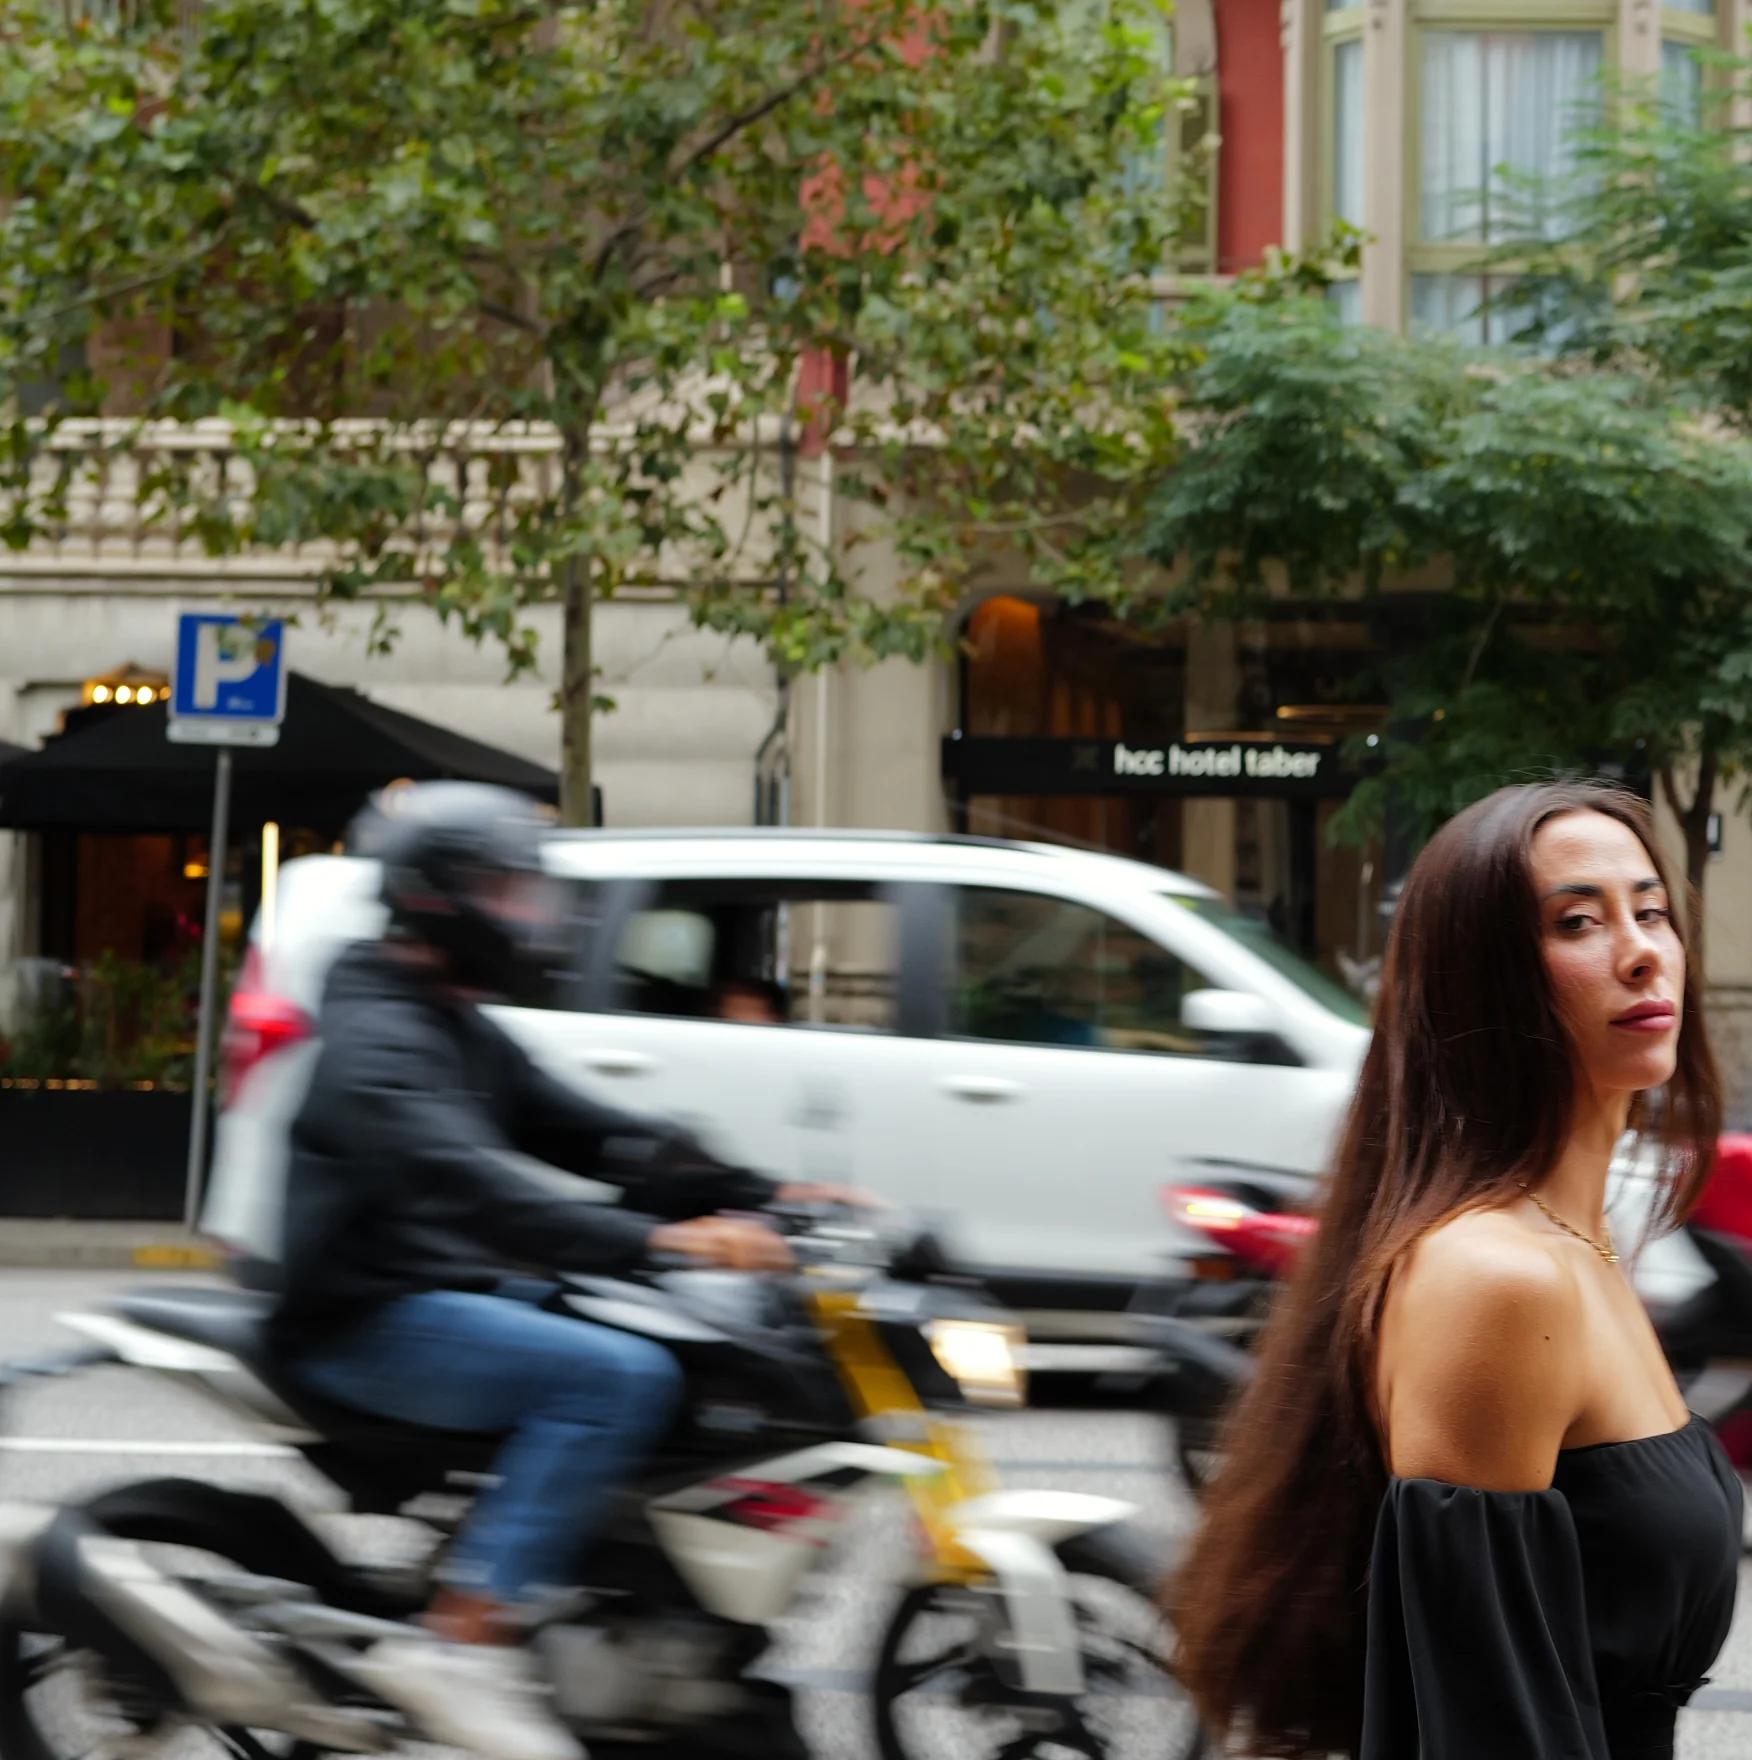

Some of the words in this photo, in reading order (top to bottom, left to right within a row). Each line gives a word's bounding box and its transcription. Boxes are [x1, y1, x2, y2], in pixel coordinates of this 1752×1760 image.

[193, 623, 261, 708] P
[1114, 742, 1165, 775] hcc
[1168, 743, 1242, 777] hotel
[1245, 744, 1322, 778] taber
